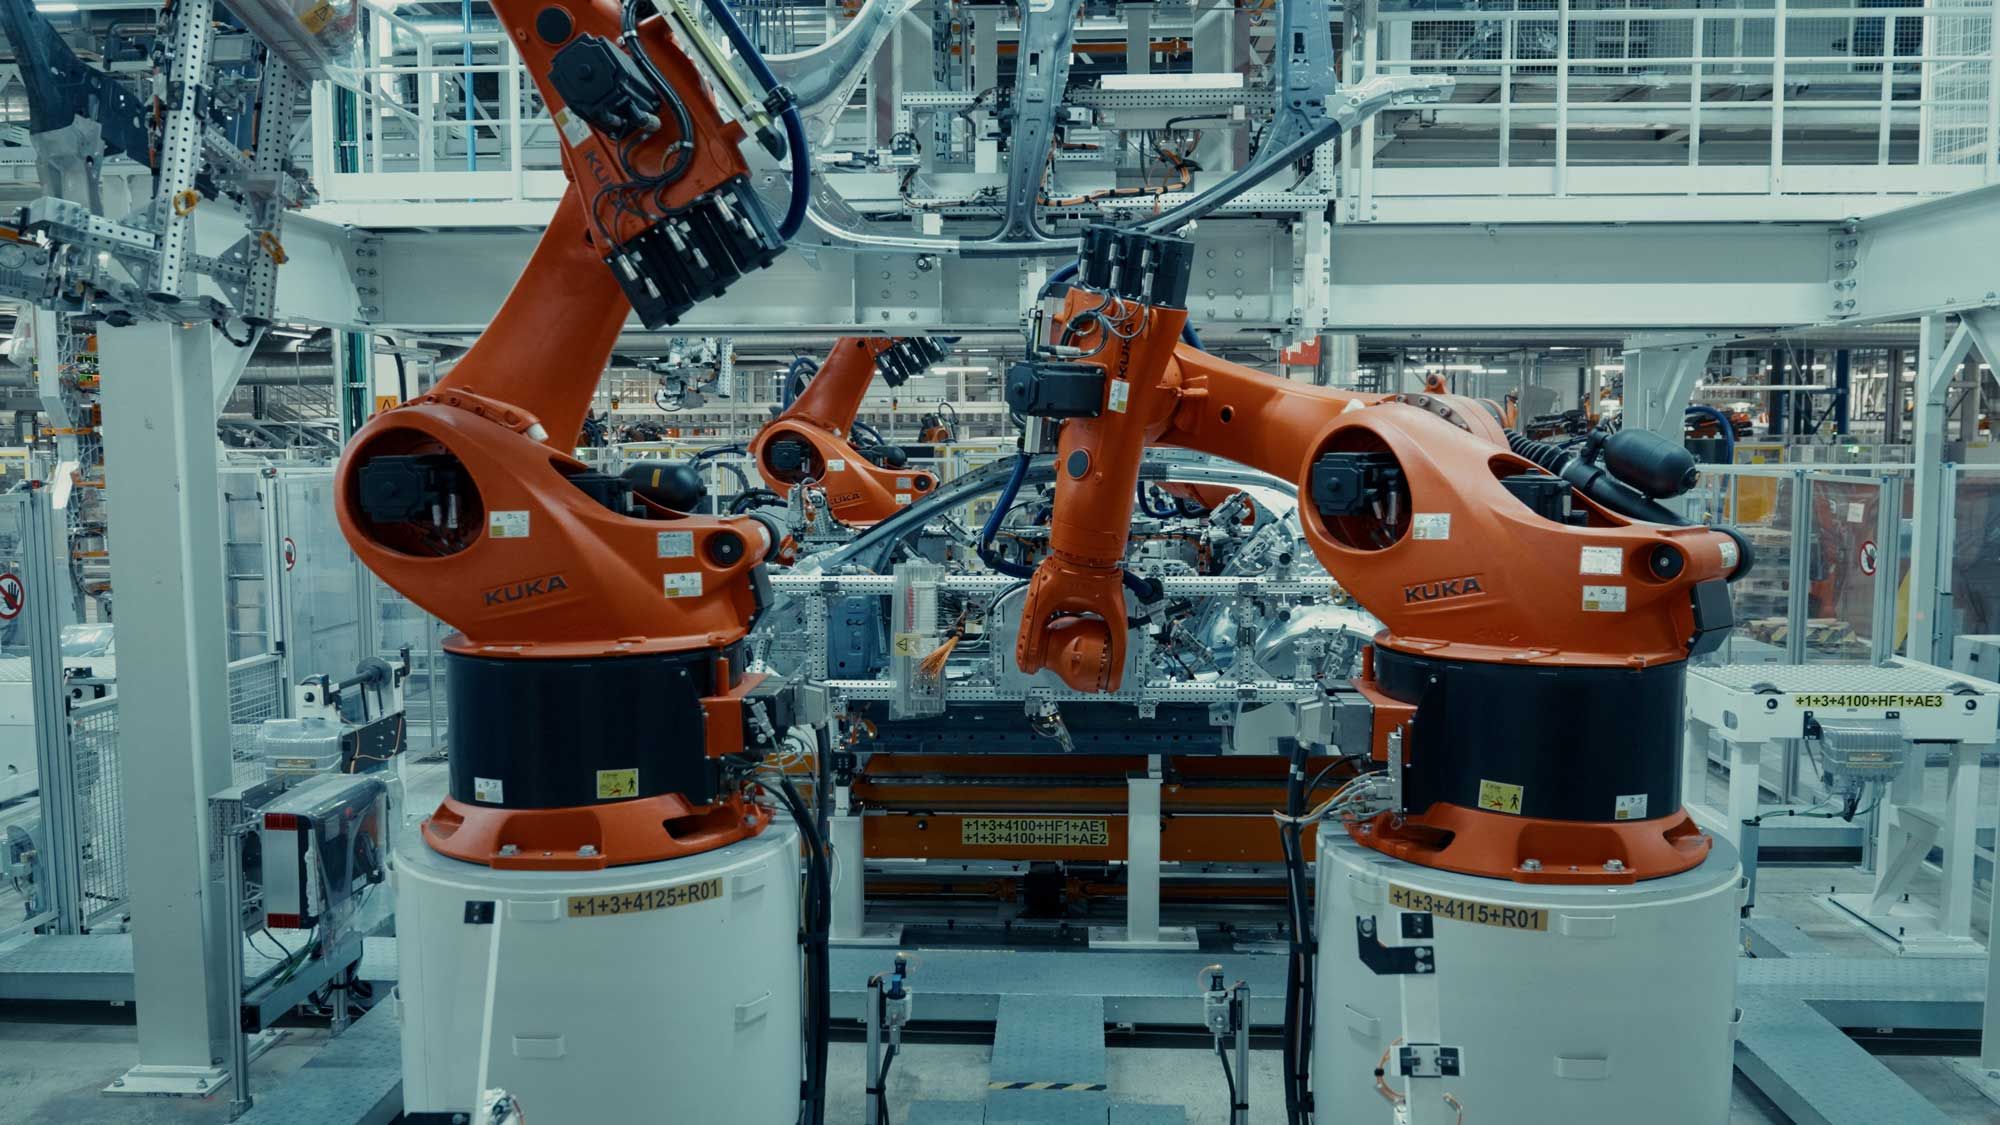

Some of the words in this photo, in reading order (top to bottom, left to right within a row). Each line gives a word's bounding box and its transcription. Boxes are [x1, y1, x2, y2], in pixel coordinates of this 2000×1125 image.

[1118, 322, 1134, 379] KUKA
[485, 575, 568, 606] KUKA
[1404, 577, 1482, 603] KUKA
[1796, 695, 1943, 707] +1+3+4100+HF1+AE3
[964, 820, 1106, 832] +1+3+4100+HF1+AE1
[964, 832, 1107, 845] +1+3+4100+HF1+AE2
[573, 880, 718, 916] +1+3+4125+R01
[1393, 890, 1539, 929] +1+3+4115+R01
